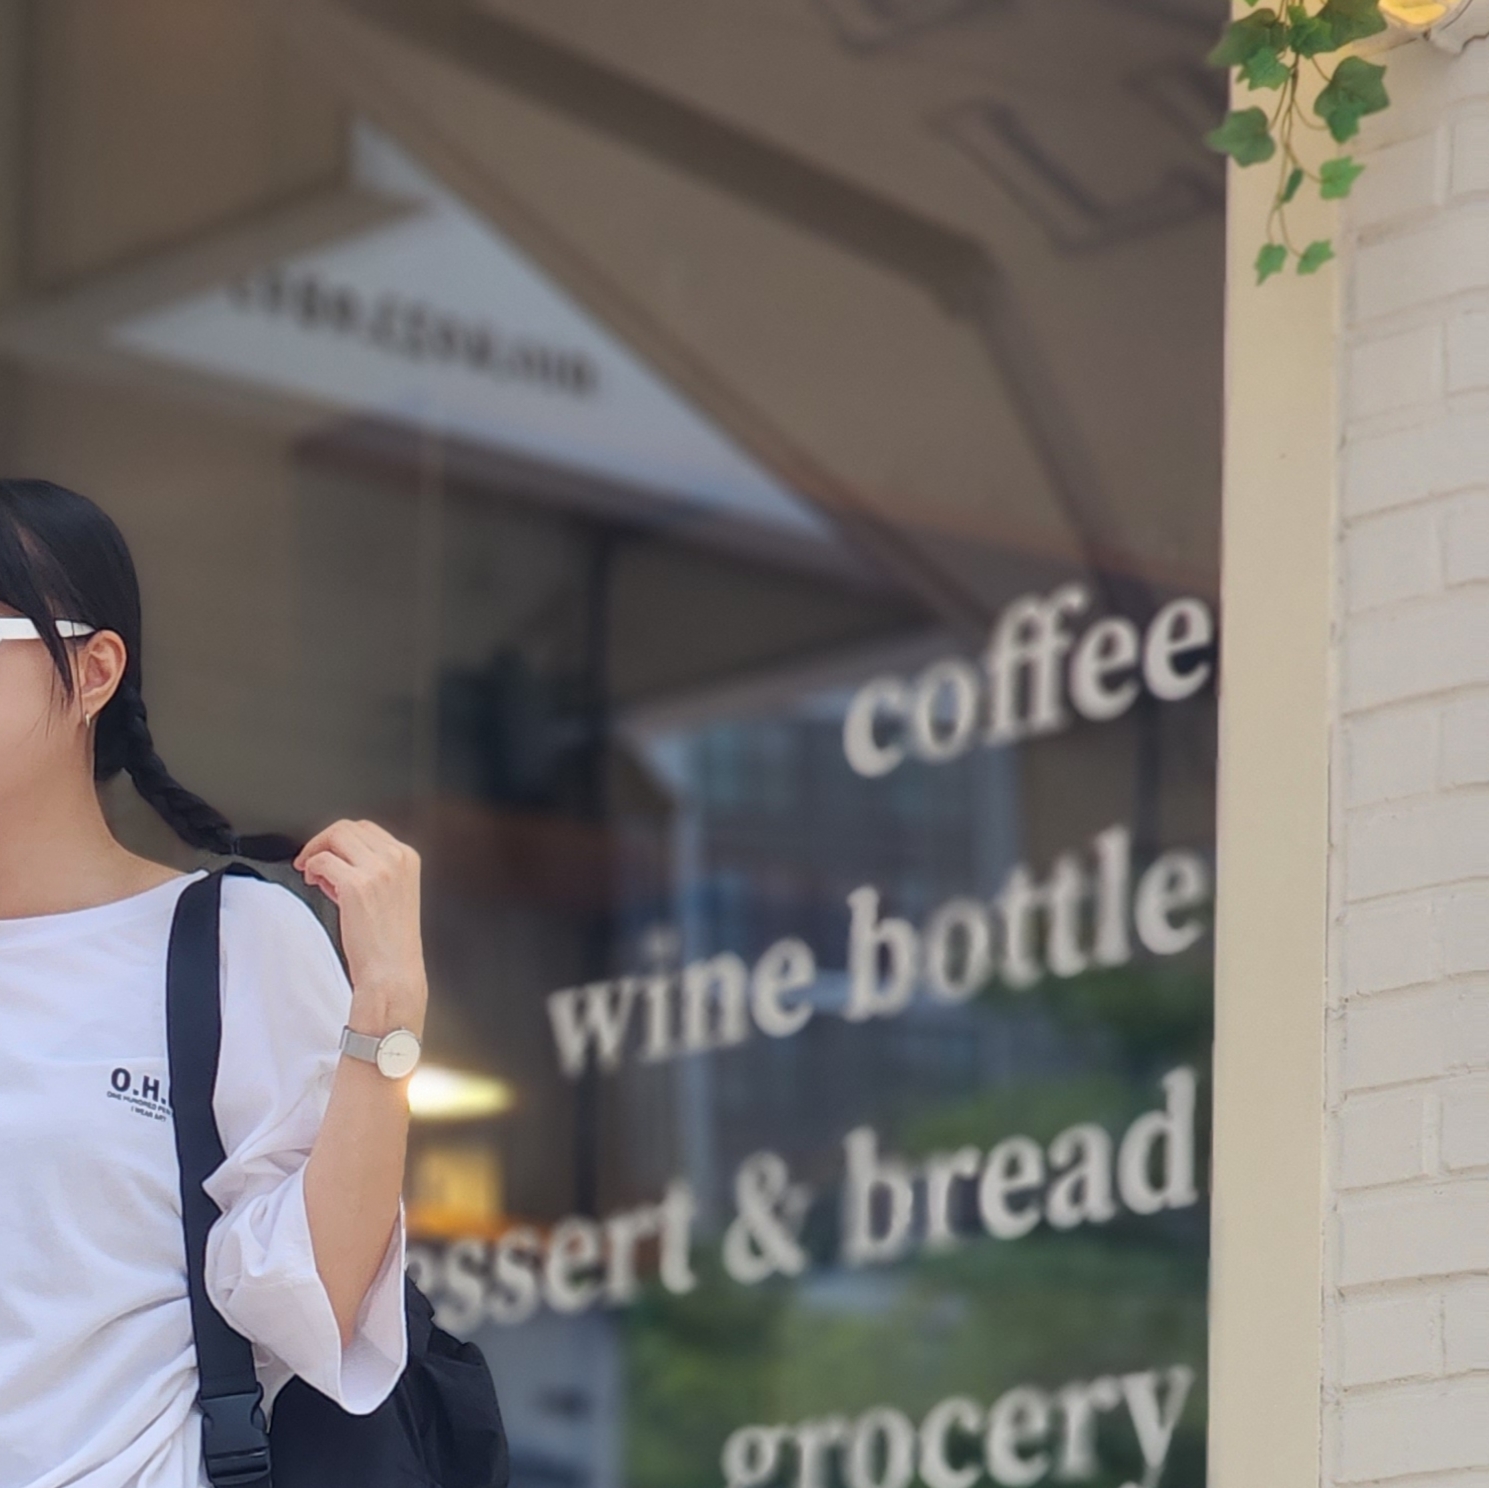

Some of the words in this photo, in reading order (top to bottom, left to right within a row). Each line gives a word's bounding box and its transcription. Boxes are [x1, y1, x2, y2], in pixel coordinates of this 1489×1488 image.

[844, 584, 1213, 777] coffee
[546, 924, 816, 1077] wine
[844, 826, 1205, 1023] bottle
[722, 1151, 811, 1285] &
[842, 1067, 1198, 1267] bread
